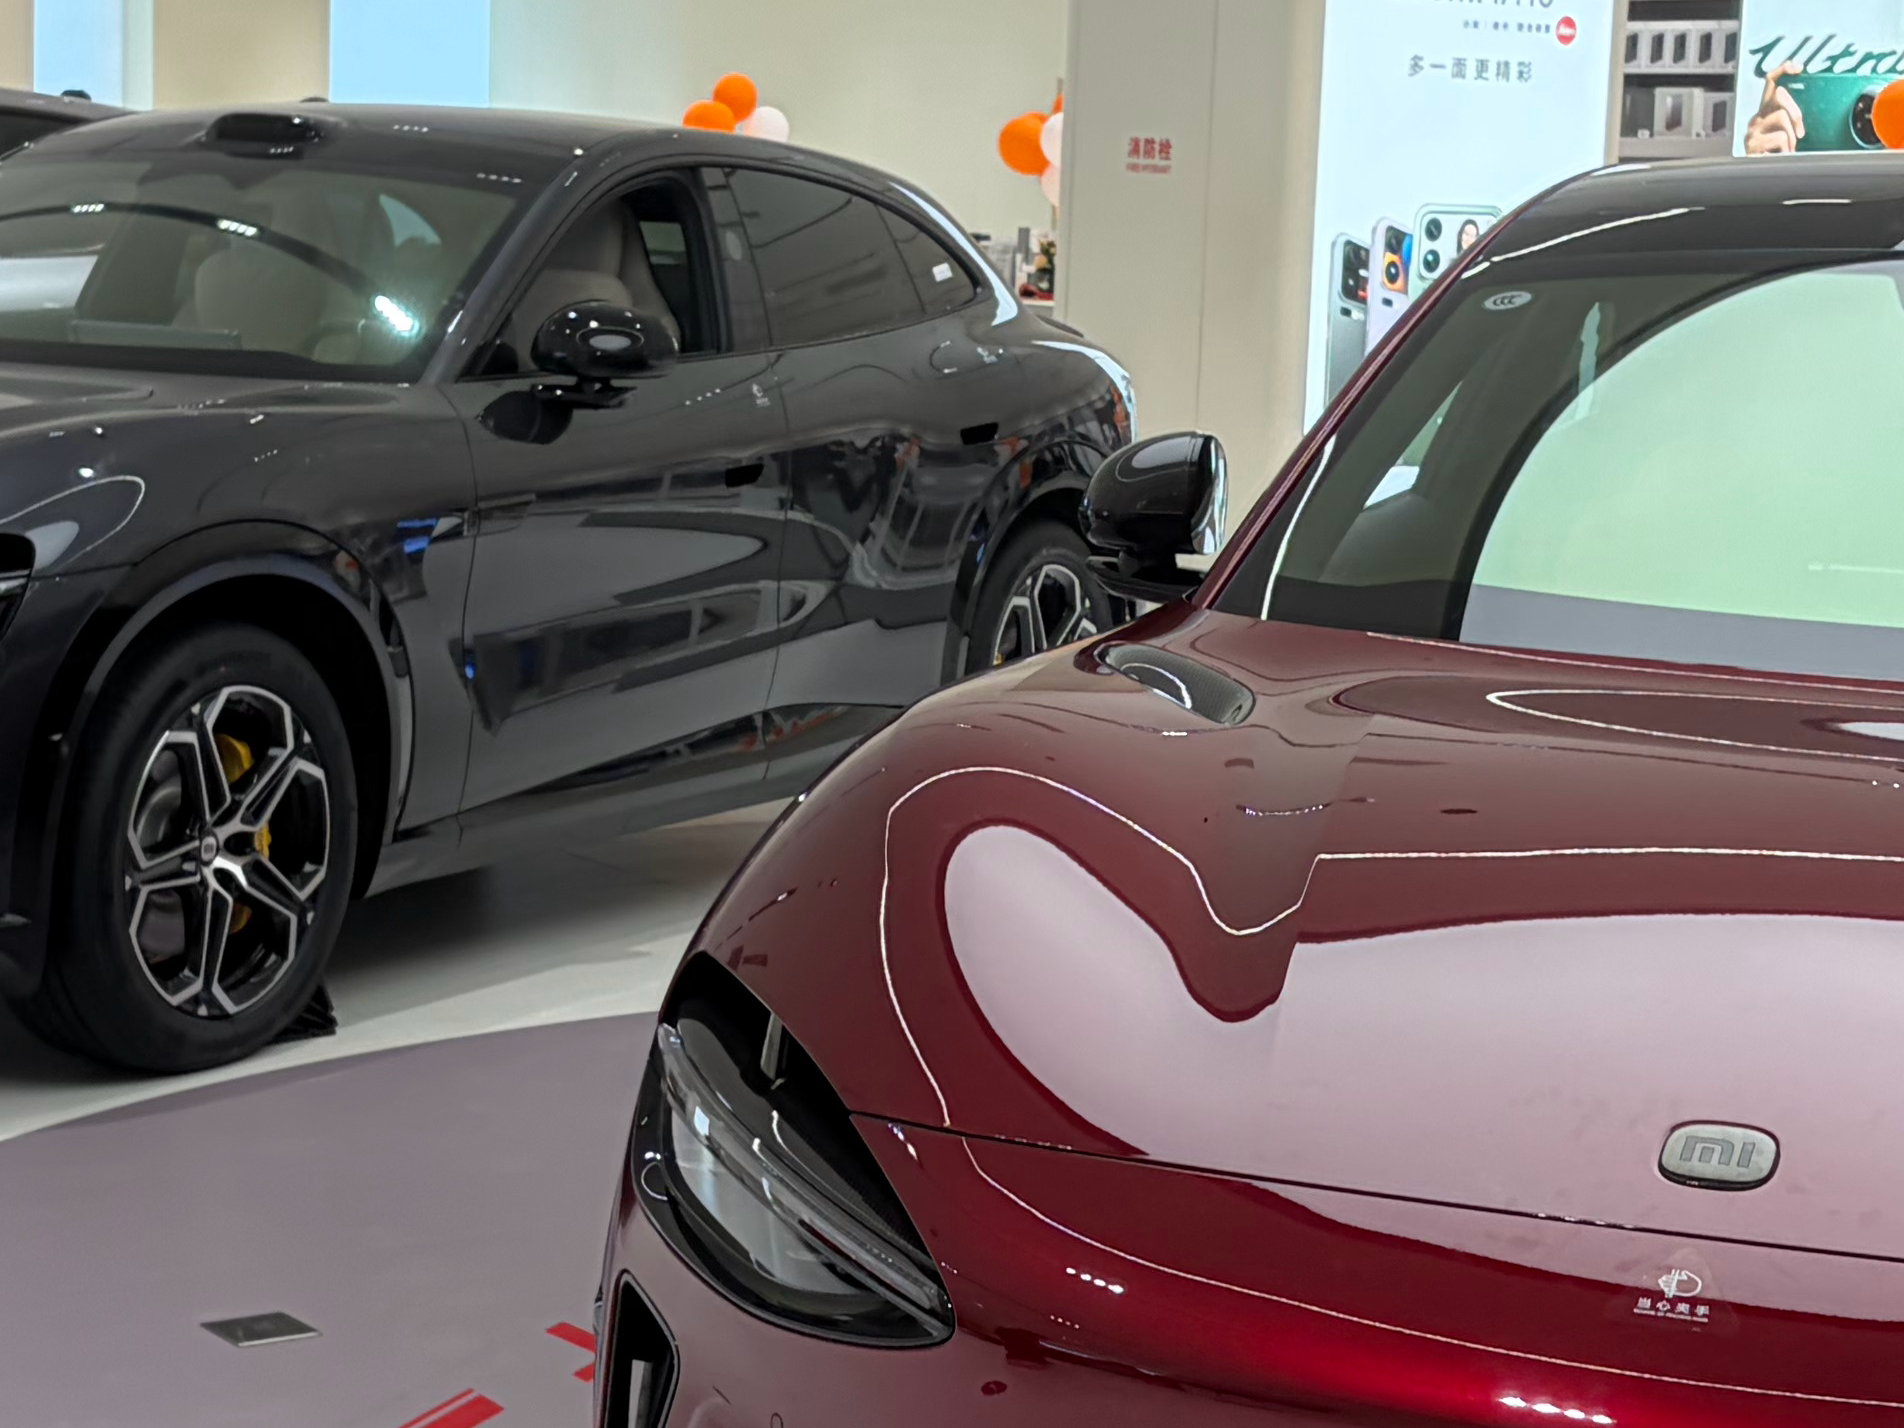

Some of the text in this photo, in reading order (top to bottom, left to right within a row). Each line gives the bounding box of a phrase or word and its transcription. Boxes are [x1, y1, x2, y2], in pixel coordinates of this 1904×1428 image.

[1407, 54, 1533, 83] 多一面更精彩
[1127, 136, 1173, 161] 消防栓
